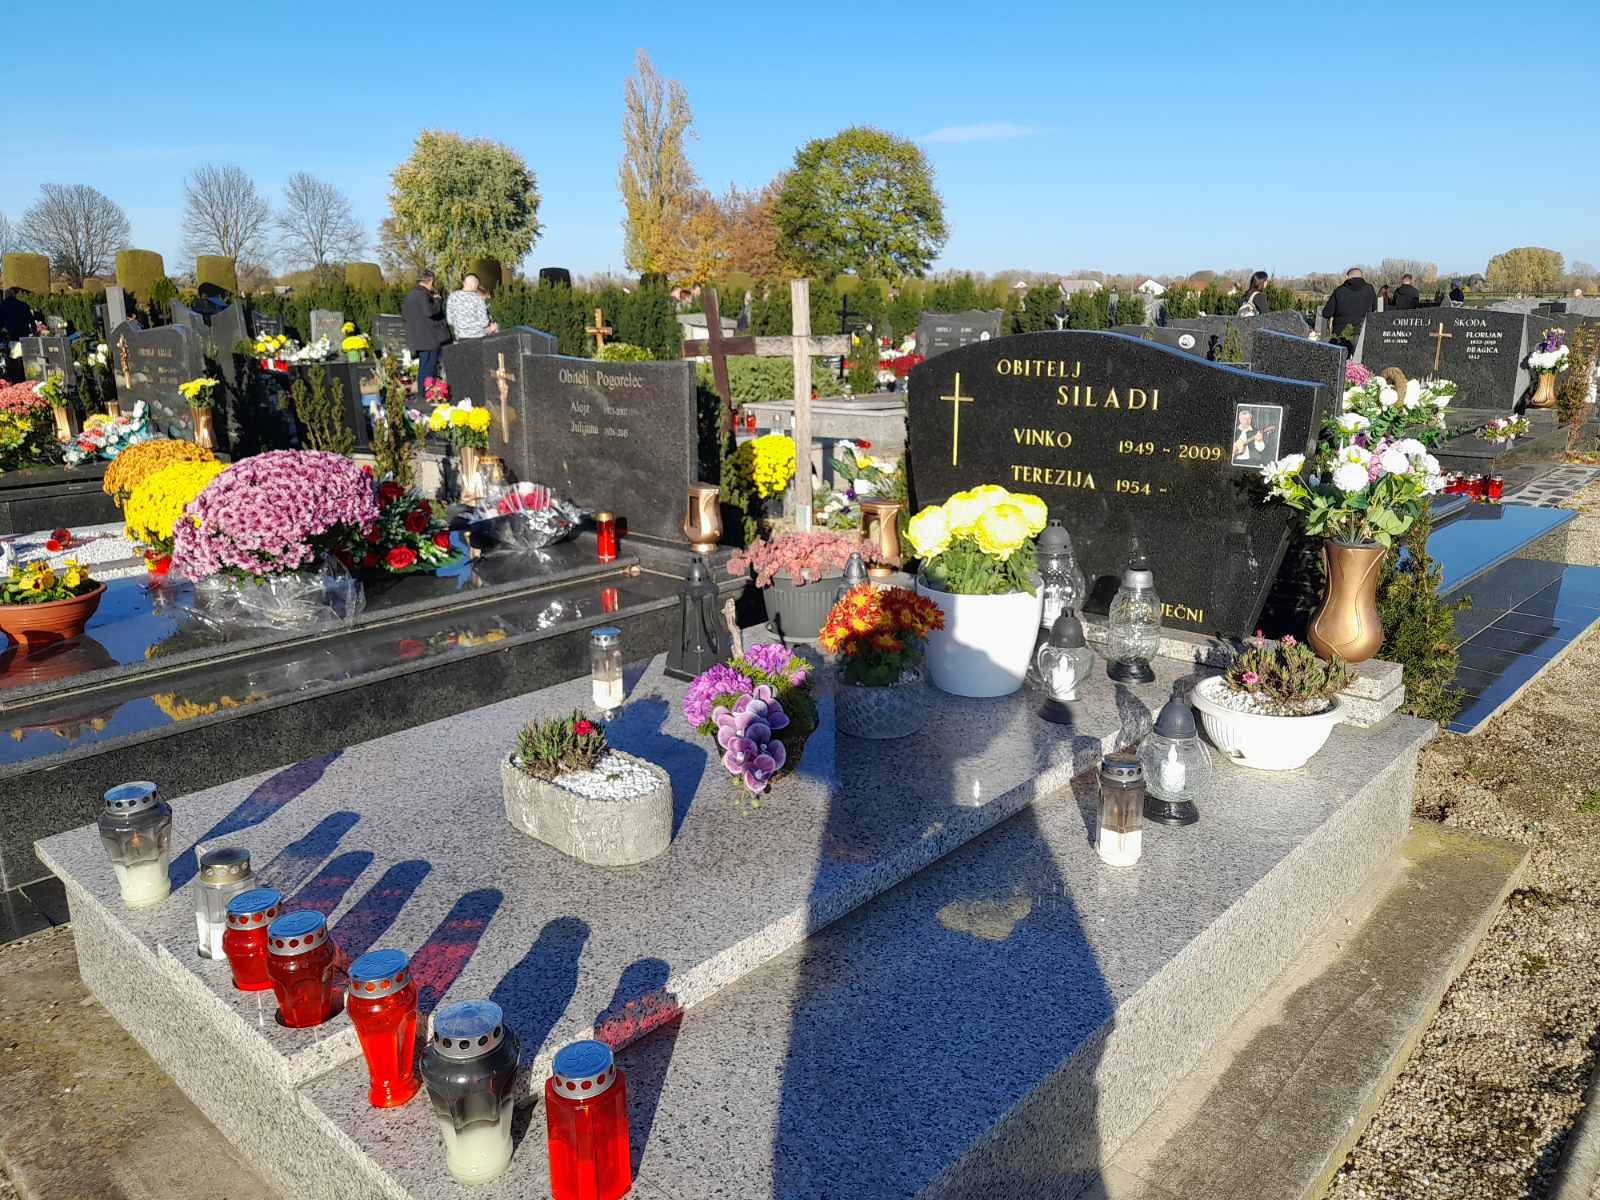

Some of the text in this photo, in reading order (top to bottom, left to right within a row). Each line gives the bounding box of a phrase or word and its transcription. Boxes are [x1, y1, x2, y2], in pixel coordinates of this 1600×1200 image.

[1453, 317, 1486, 327] ŠKODA
[560, 368, 642, 390] Obitelj Pogorelec
[997, 358, 1081, 378] OBITELJ
[1057, 384, 1159, 411] SILADI
[1013, 428, 1072, 448] VINKO
[1119, 440, 1154, 455] 1949
[1178, 444, 1221, 461] 2009
[1010, 465, 1096, 489] TEREZIJA
[1115, 479, 1151, 495] 1954
[1156, 602, 1204, 623] JEČNI
